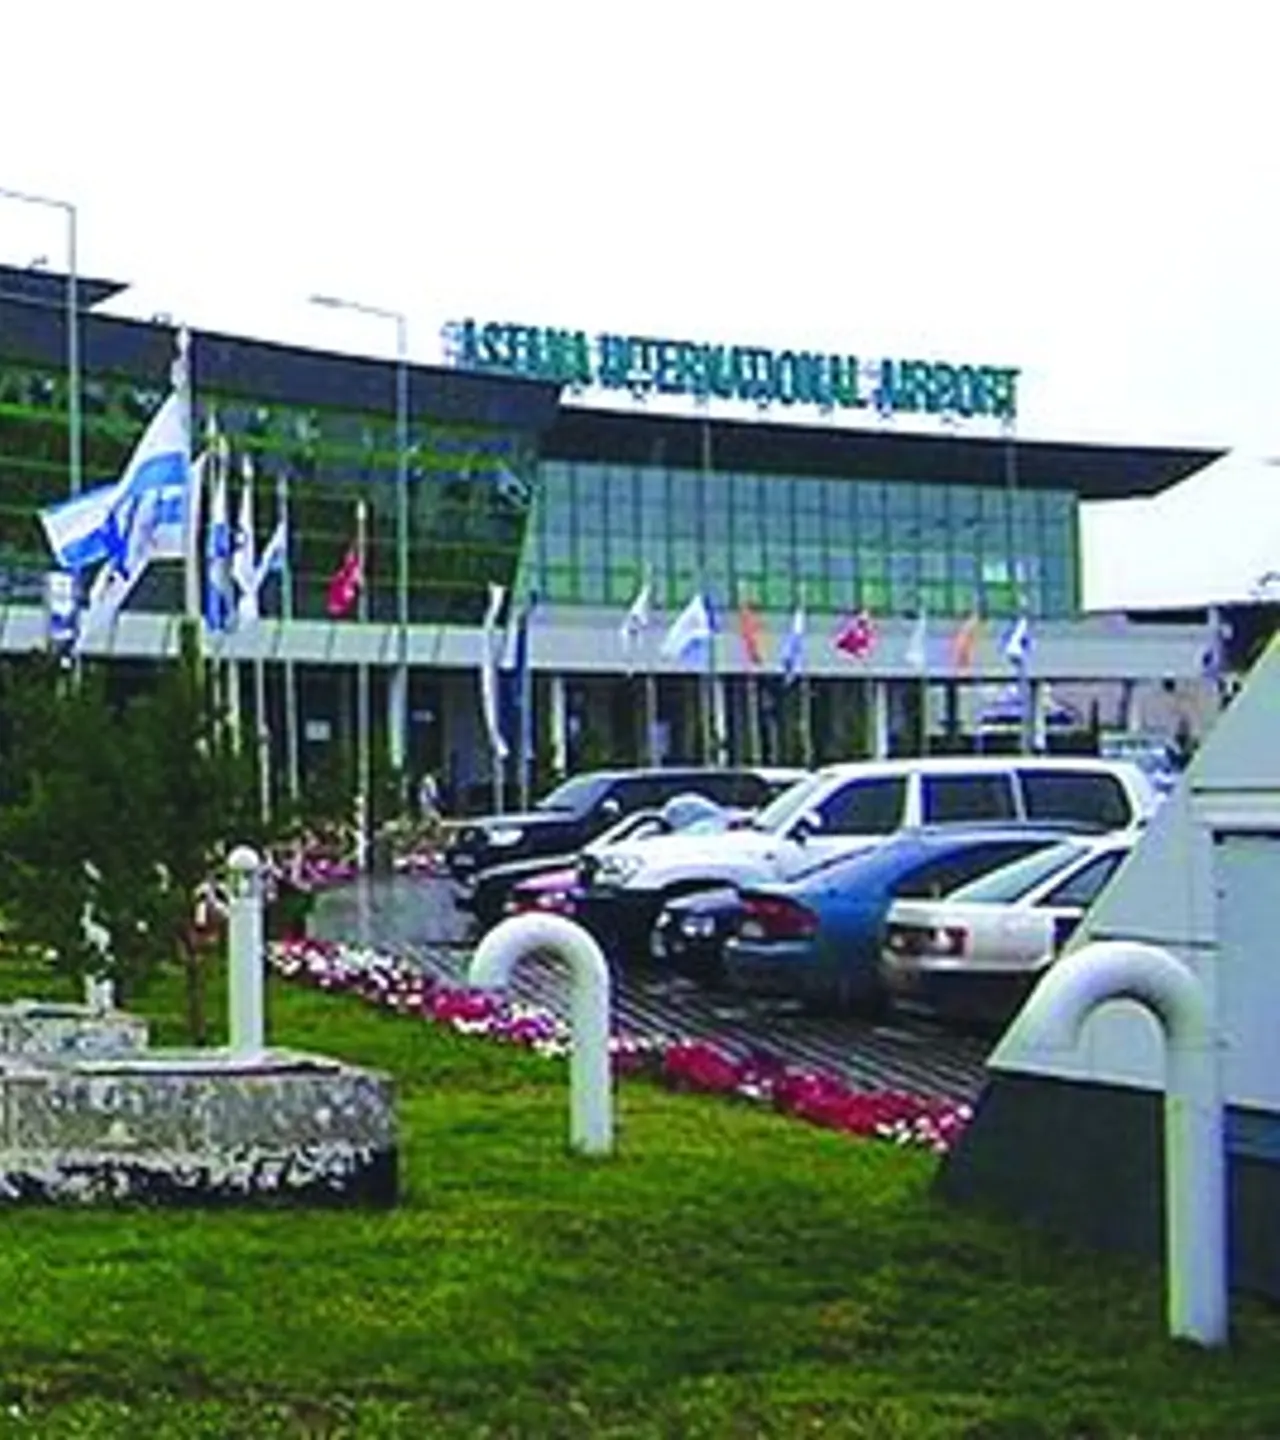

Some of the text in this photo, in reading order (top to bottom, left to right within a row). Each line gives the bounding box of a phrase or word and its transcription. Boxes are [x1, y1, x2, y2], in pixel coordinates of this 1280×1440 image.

[444, 317, 1020, 417] ASTANA INTERNATIONAL AIRPORT
